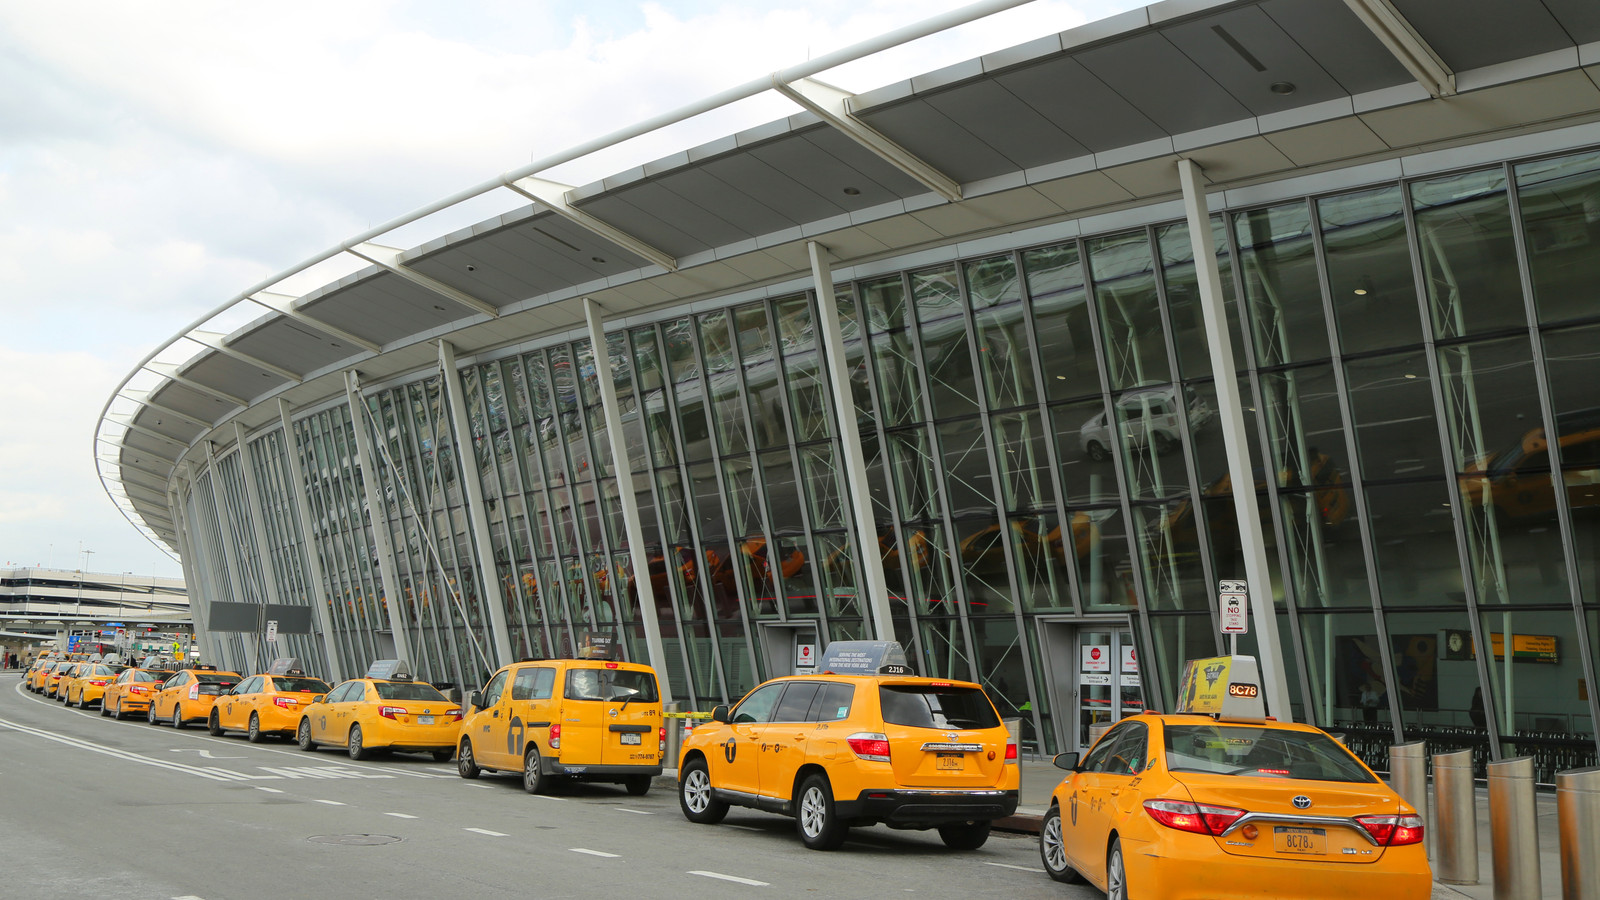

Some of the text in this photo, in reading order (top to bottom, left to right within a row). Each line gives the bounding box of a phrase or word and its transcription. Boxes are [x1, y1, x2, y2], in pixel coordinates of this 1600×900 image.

[888, 666, 904, 674] 2J16
[1230, 685, 1257, 695] 8C78
[203, 766, 399, 779] LANE
